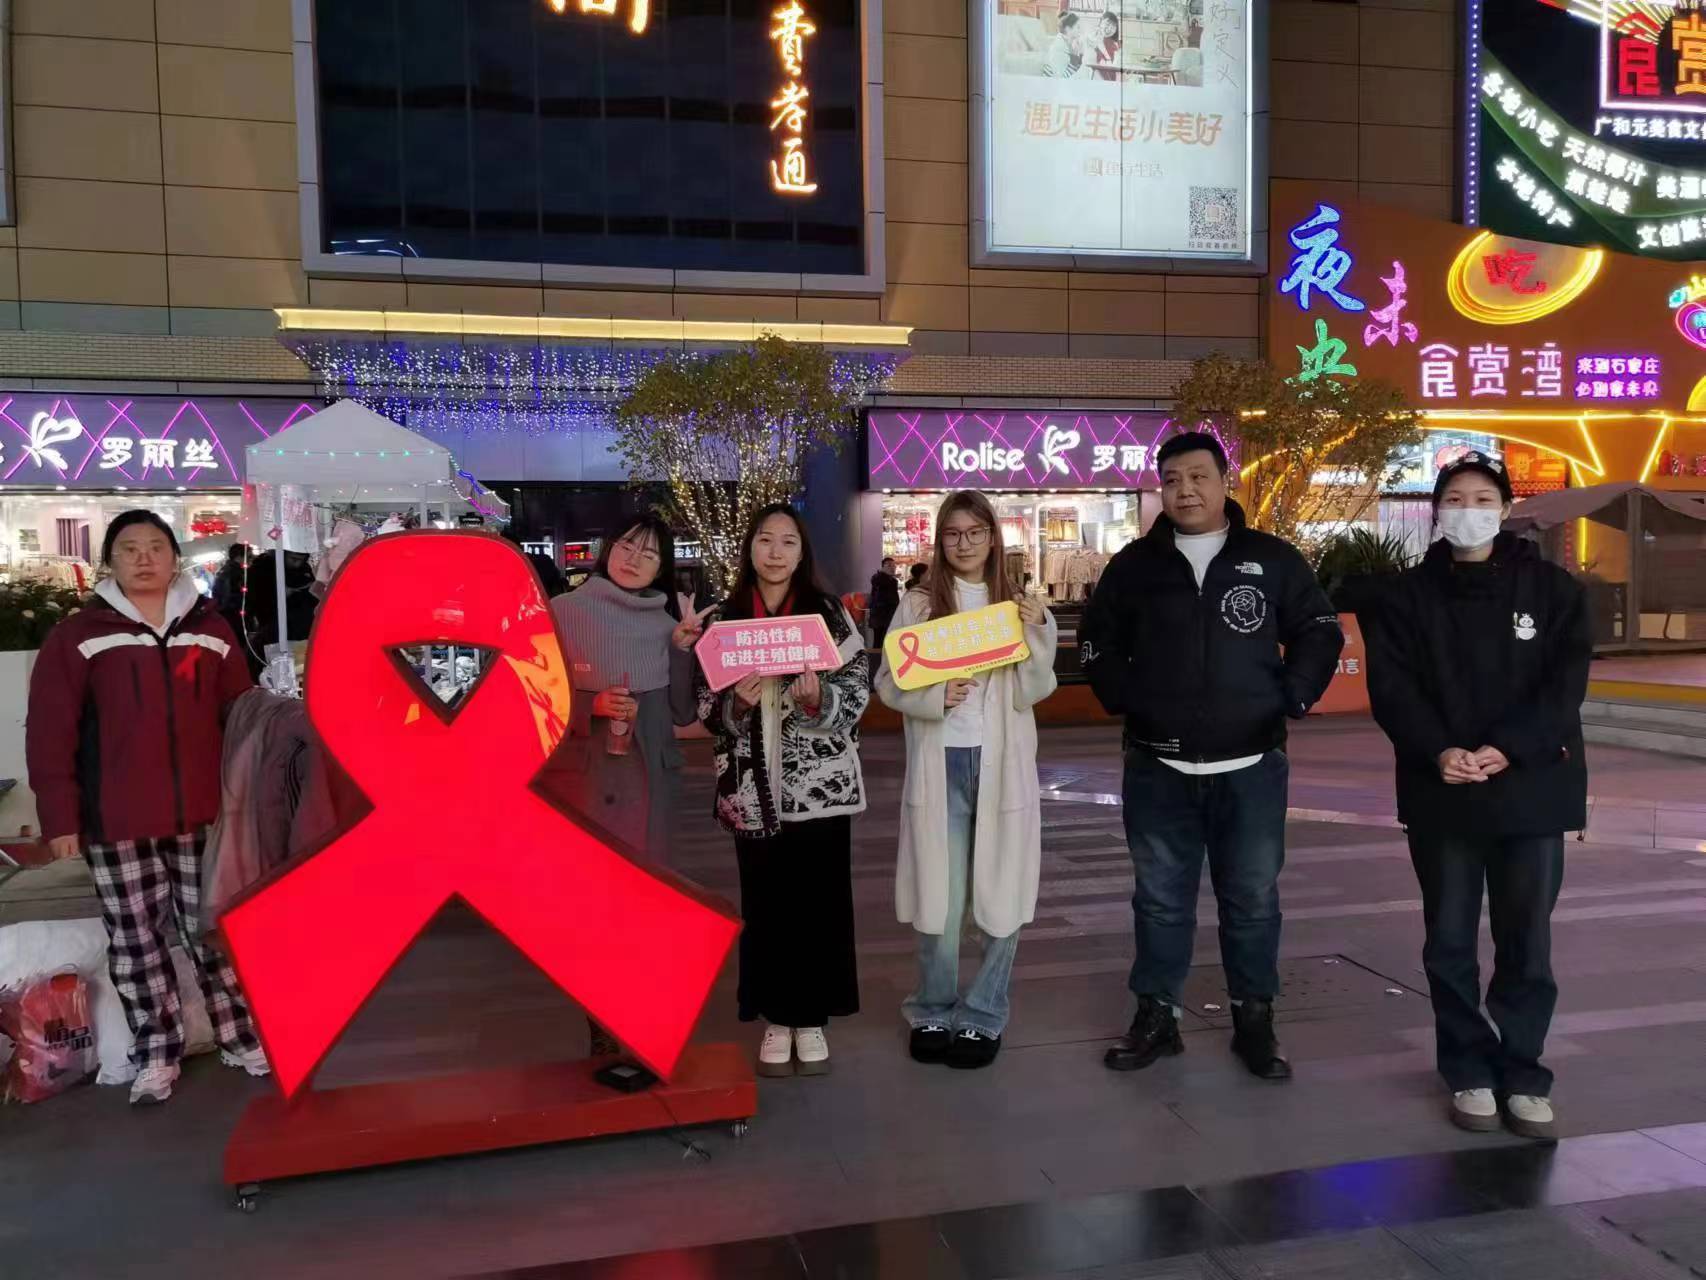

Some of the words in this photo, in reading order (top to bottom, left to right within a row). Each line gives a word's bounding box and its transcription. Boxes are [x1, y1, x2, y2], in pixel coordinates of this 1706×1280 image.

[1021, 101, 1224, 146] 遇见生活小美好
[1482, 249, 1547, 295] 吃
[1419, 342, 1562, 398] 食赏湾
[99, 436, 219, 470] 罗丽丝
[942, 441, 1026, 472] Rolise
[735, 626, 802, 647] 防治性病
[721, 644, 820, 668] 促进生殖健康
